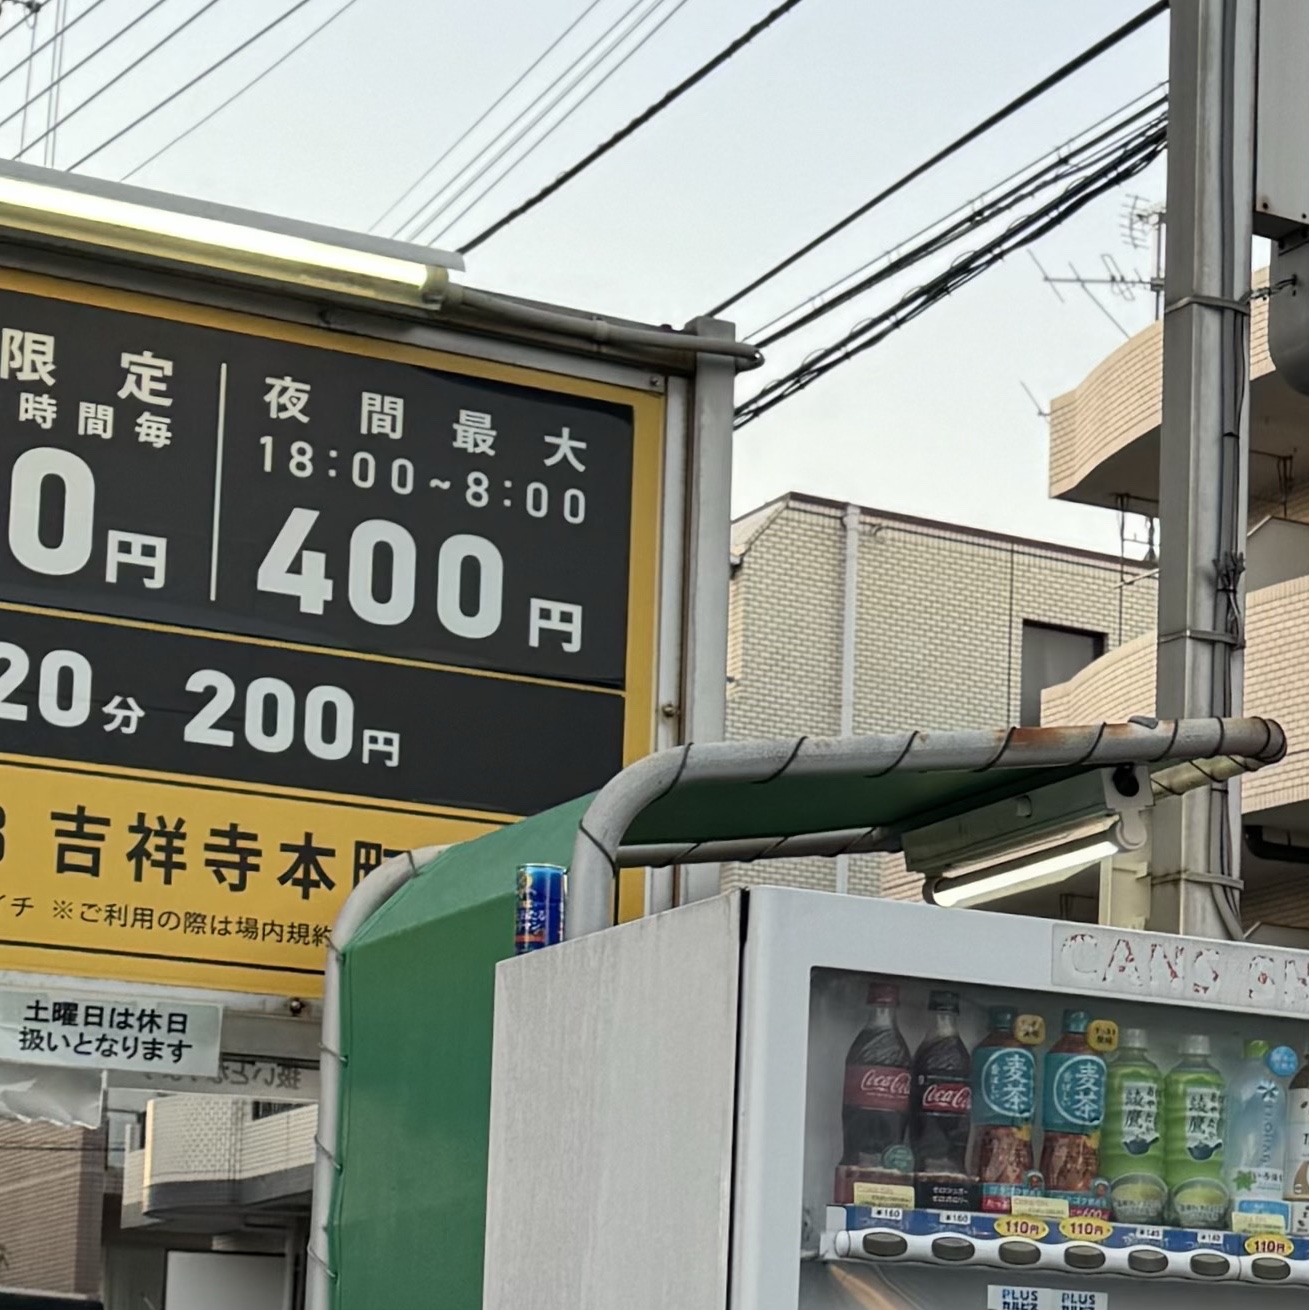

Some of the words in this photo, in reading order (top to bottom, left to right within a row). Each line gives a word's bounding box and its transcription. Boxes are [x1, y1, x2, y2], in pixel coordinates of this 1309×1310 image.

[263, 374, 589, 474] 夜間最大
[256, 506, 584, 655] 400円
[182, 669, 401, 769] 200円
[23, 999, 189, 1035] 土曜日は休日
[18, 1026, 193, 1064] 扱いとなります
[1002, 1053, 1029, 1114] 麦茶
[1072, 1061, 1101, 1121] 麦茶
[1004, 1219, 1040, 1236] 110円
[1069, 1221, 1104, 1237] 110円
[1253, 1239, 1285, 1254] 110円
[1001, 1288, 1039, 1301] PLUS
[1061, 1292, 1096, 1305] PLUS
